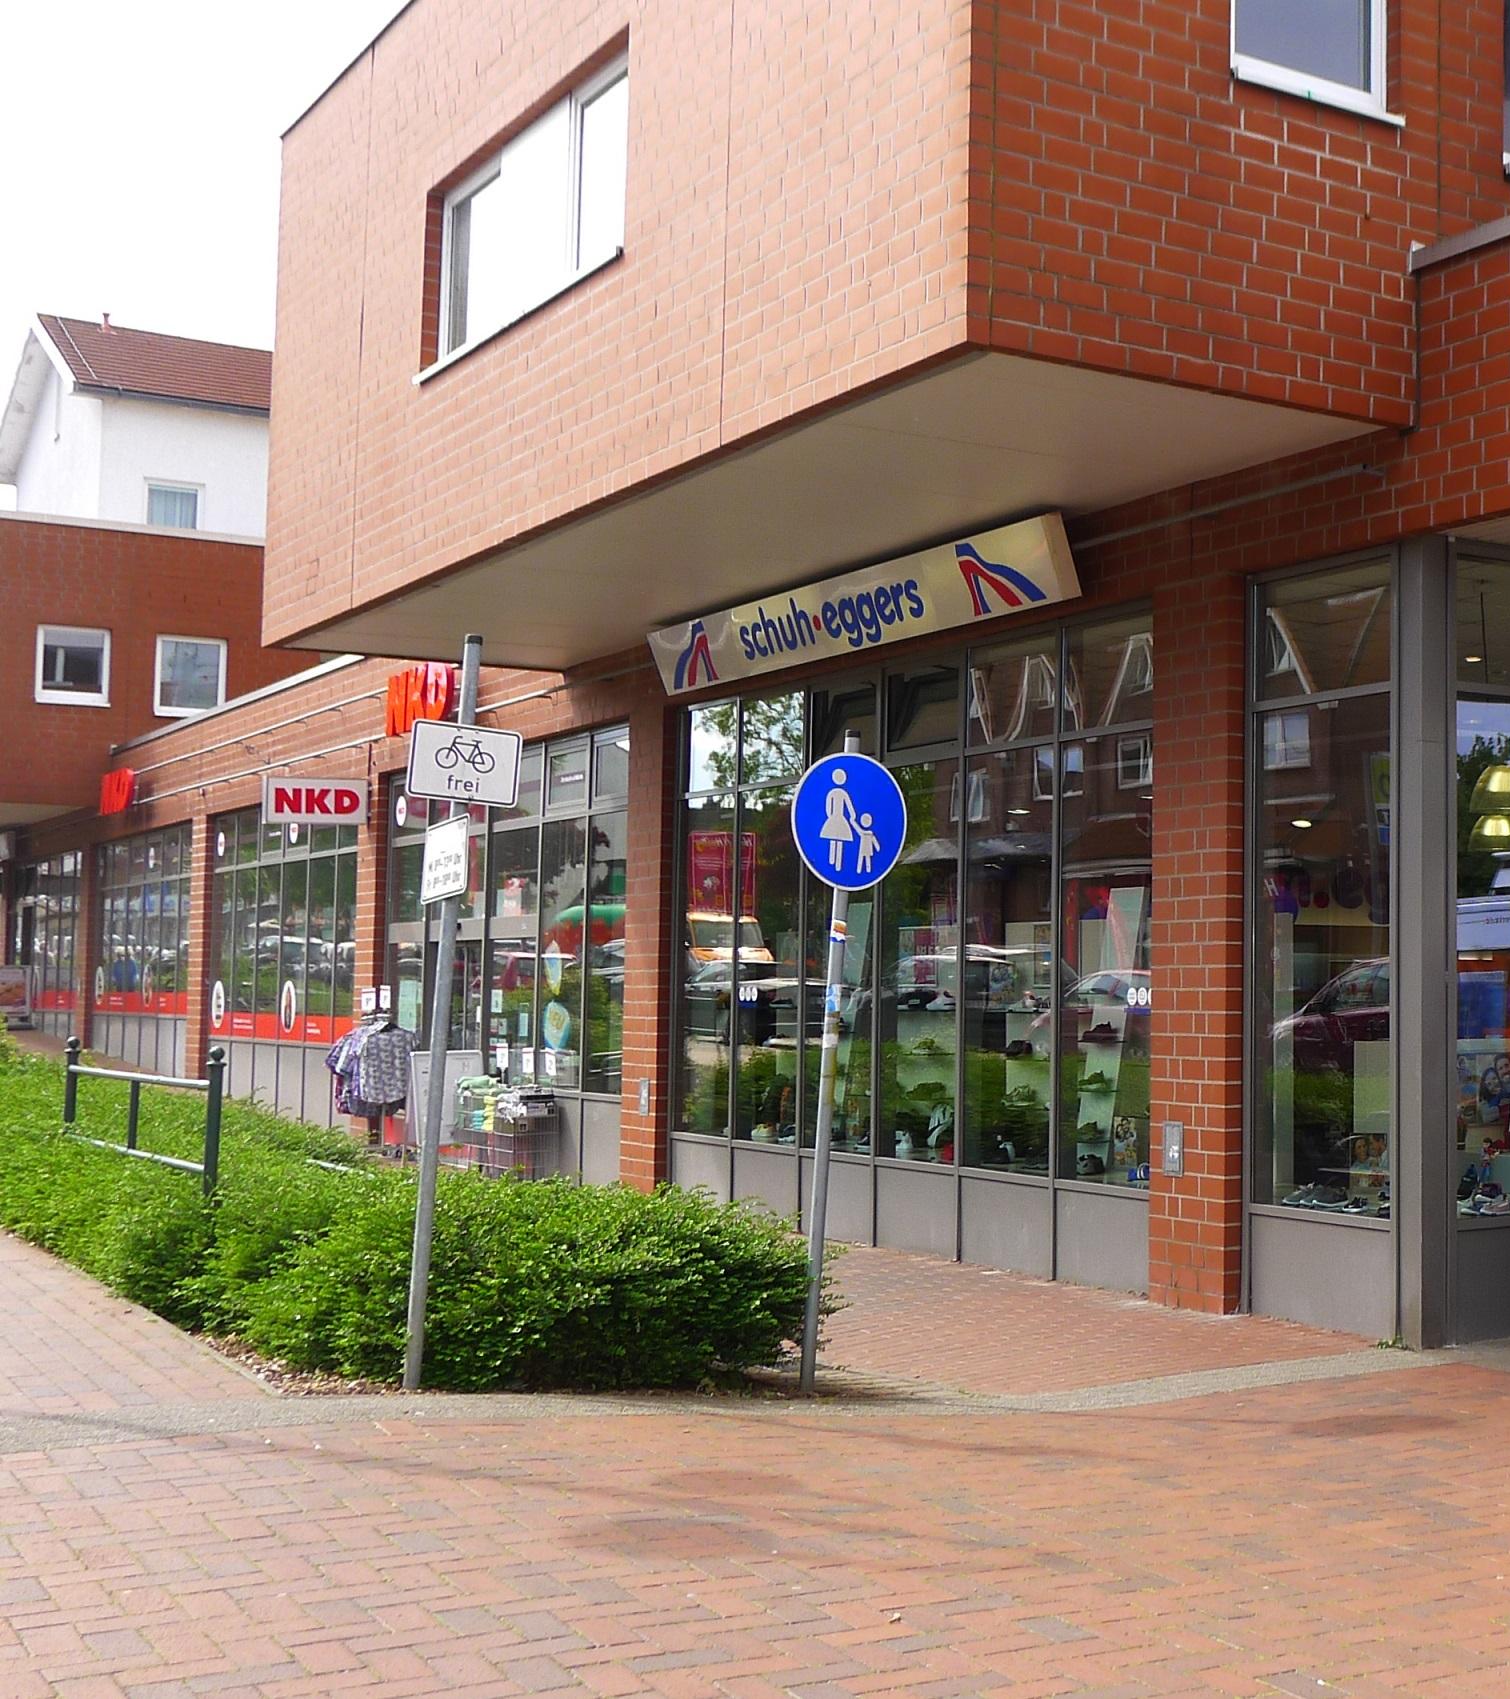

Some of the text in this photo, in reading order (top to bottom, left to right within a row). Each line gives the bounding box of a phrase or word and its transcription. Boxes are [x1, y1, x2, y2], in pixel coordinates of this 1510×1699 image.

[386, 662, 453, 736] NKD
[447, 774, 480, 793] frei
[274, 787, 361, 815] NKD
